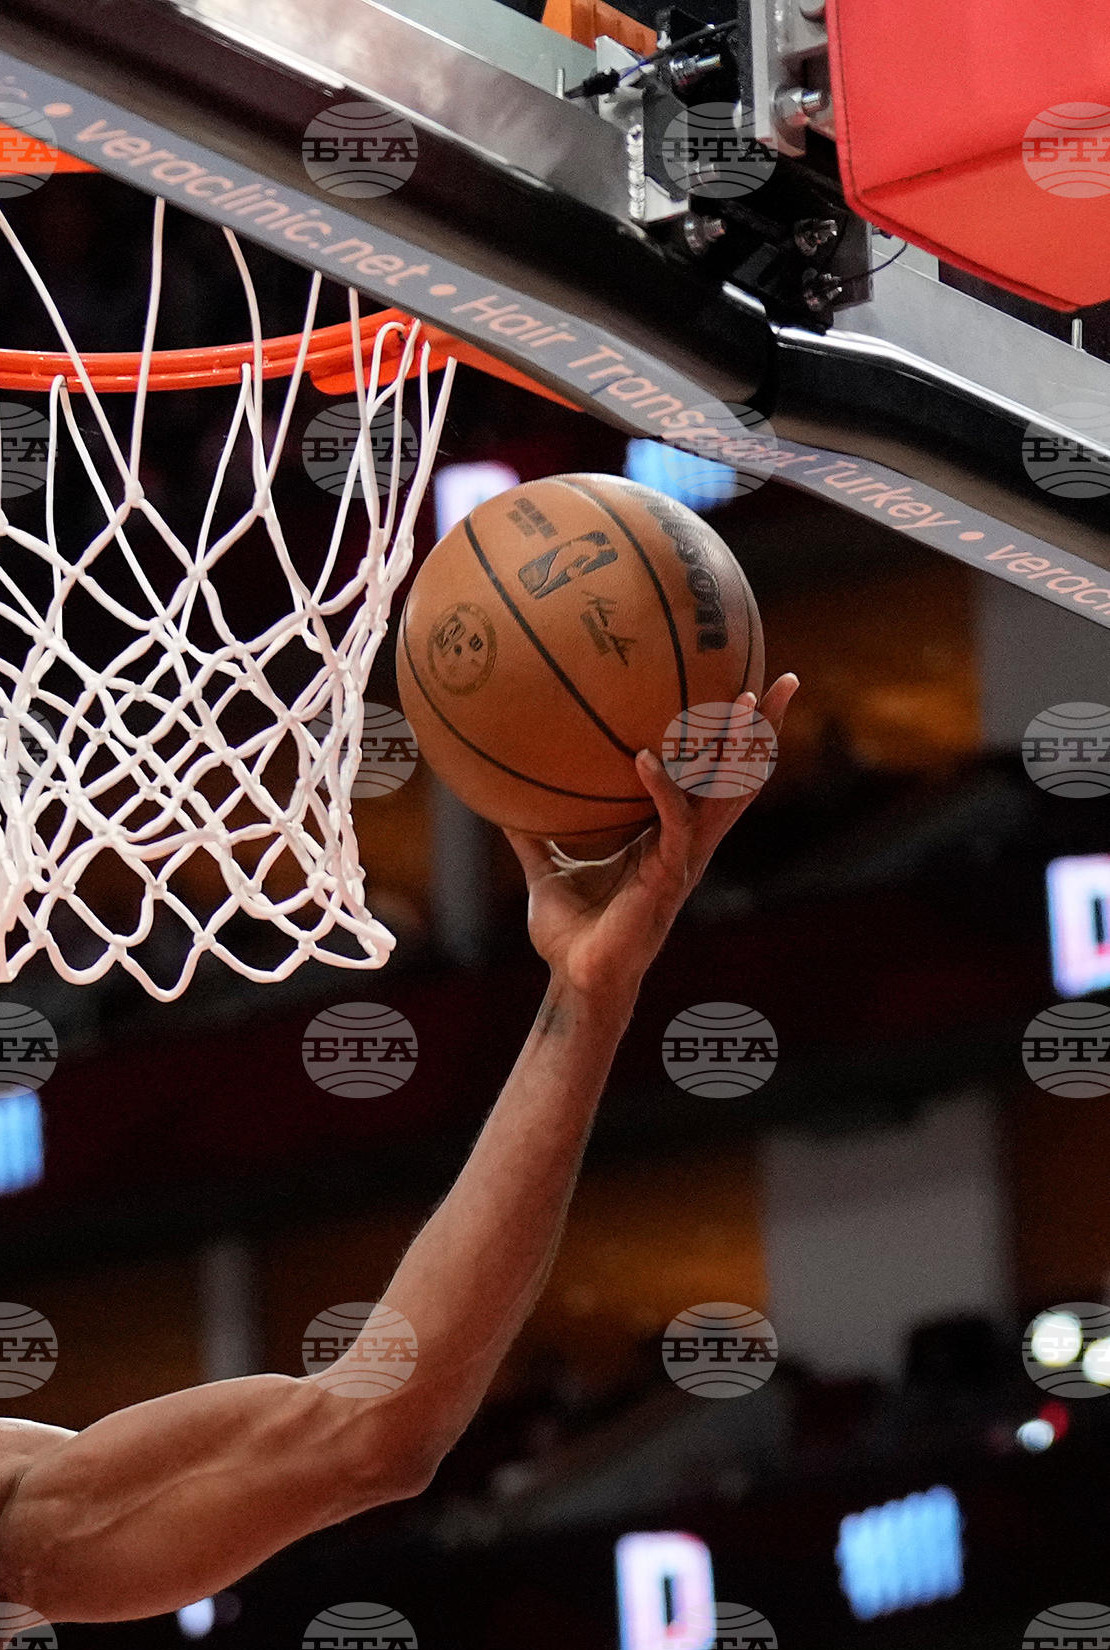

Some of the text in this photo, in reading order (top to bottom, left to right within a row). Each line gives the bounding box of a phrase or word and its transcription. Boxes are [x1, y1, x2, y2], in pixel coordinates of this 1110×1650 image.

[77, 119, 431, 287] veraclinic.net
[451, 294, 576, 348] Hair
[804, 460, 961, 530] Turkey
